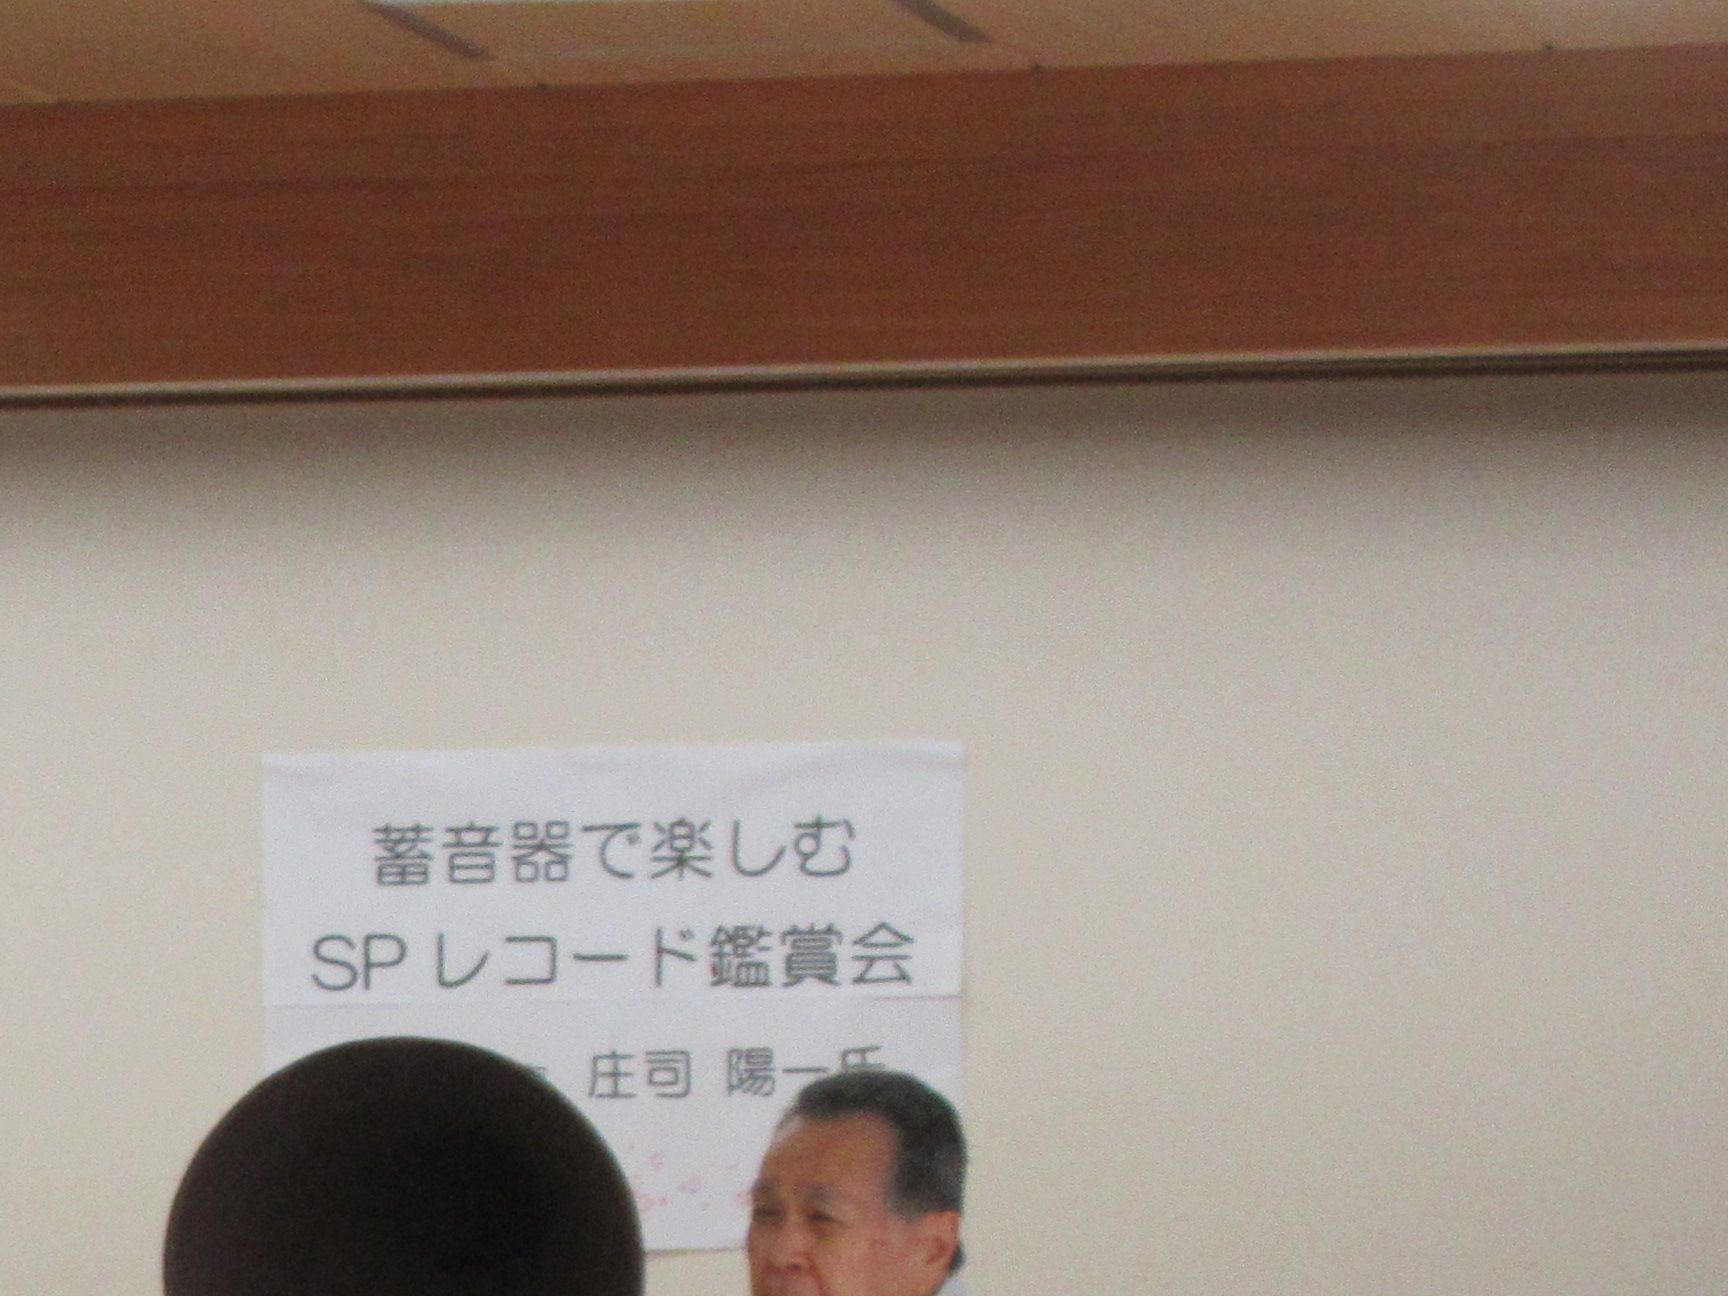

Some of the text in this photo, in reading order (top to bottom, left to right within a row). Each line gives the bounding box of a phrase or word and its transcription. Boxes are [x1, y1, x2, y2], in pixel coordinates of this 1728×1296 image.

[372, 815, 856, 887] 蓄音器で楽しむ
[311, 922, 915, 991] SPレコード鑑賞会
[588, 1050, 692, 1100] 庄司
